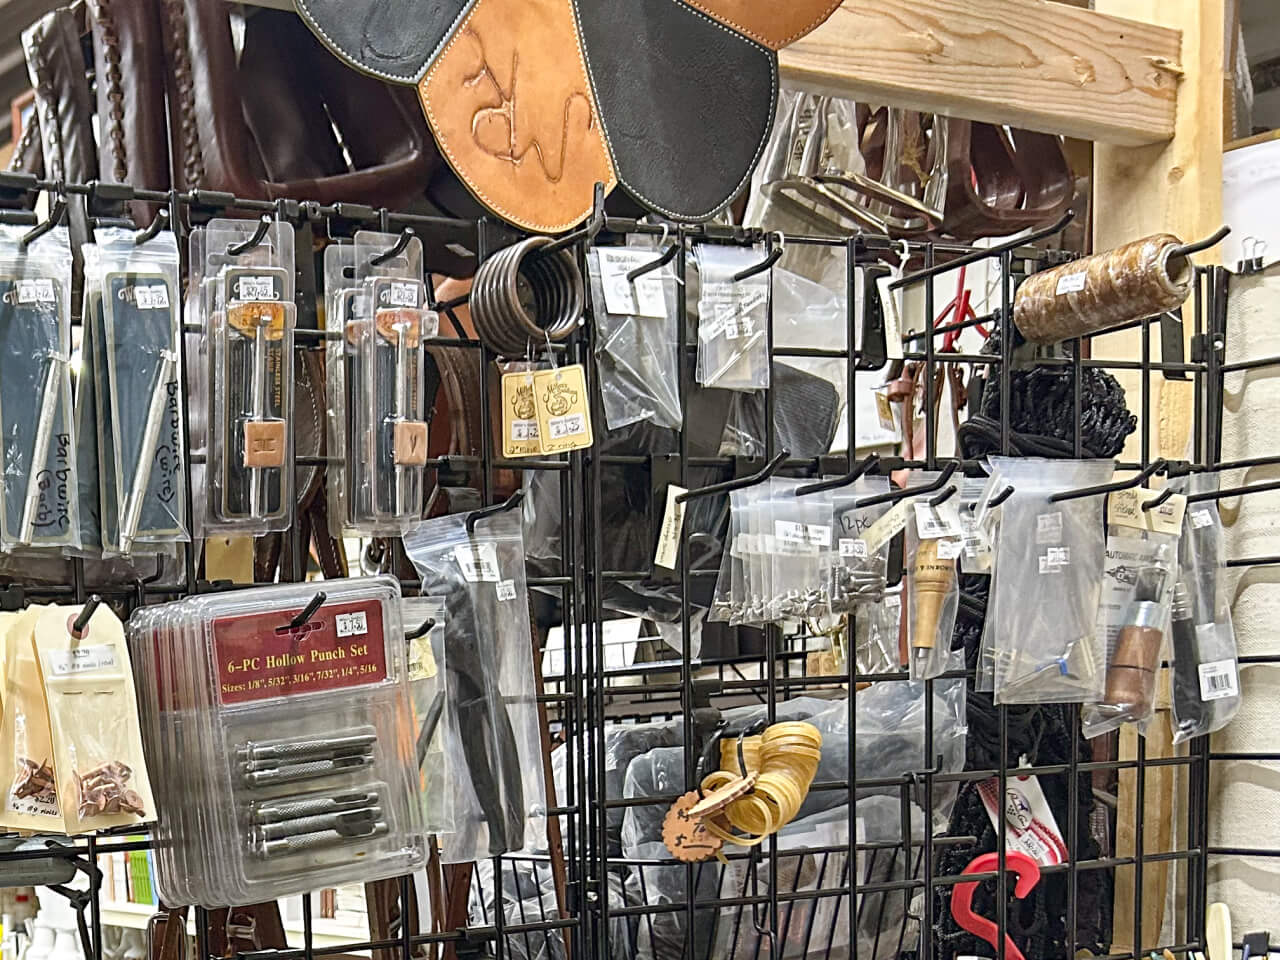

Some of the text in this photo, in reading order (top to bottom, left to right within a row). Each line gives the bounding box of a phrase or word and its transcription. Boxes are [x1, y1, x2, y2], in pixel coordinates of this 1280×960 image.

[154, 445, 175, 503] (wire)
[266, 654, 305, 668] Hollow
[311, 646, 345, 662] Punch
[350, 643, 368, 656] Set
[221, 683, 246, 693] Sizes:
